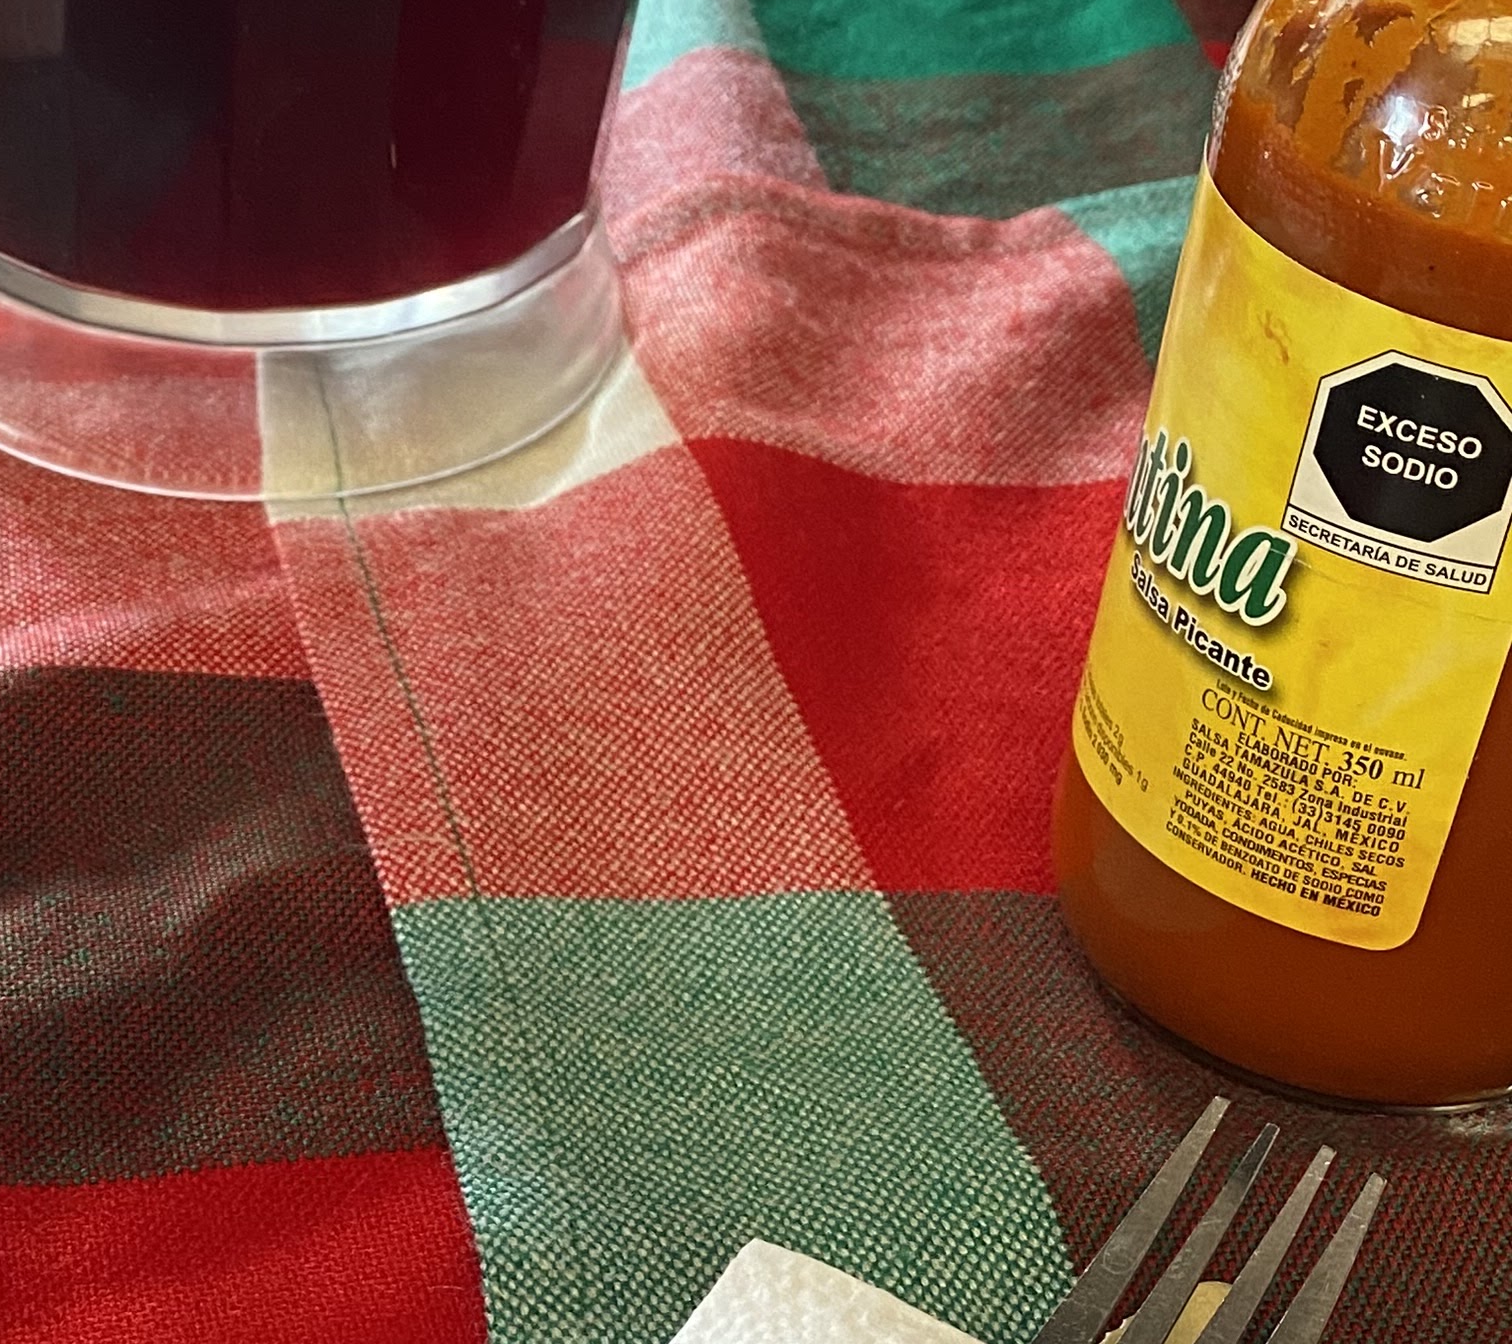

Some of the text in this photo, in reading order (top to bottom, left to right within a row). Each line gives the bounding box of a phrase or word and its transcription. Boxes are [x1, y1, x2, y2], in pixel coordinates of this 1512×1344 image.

[1357, 405, 1482, 459] EXCESO
[1361, 445, 1458, 489] SODIO
[1288, 514, 1487, 586] SECRETARÍA DE SALUD
[1131, 554, 1271, 688] Salsa Picante
[1191, 717, 1229, 751] SALSA
[1235, 743, 1308, 787] TAMAZULA
[1314, 779, 1345, 799] S.A.
[1352, 791, 1374, 806] DE
[1202, 688, 1425, 789] CONT. NET. 350 ml
[1238, 732, 1357, 788] ELABORADO POR:
[1182, 757, 1285, 823] GUADALAJARA,
[1190, 731, 1408, 827] Calle 22 No. 2583 Zona Industrial
[1213, 763, 1251, 791] 44940
[1367, 823, 1405, 840] 0090
[1173, 765, 1256, 823] INGREDIENTES:
[1306, 834, 1354, 856] CHILES
[1358, 849, 1405, 868] SECOS
[1170, 807, 1176, 818] Y
[1204, 831, 1219, 846] DE
[1220, 840, 1280, 875] BENZOATO
[1283, 868, 1300, 882] DE
[1303, 875, 1342, 895] SODIO
[1346, 887, 1384, 904] COMO
[1250, 868, 1297, 894] HECHO
[1300, 887, 1320, 902] EN
[1322, 867, 1387, 891] ESPECIAS
[1351, 861, 1377, 876] SAL
